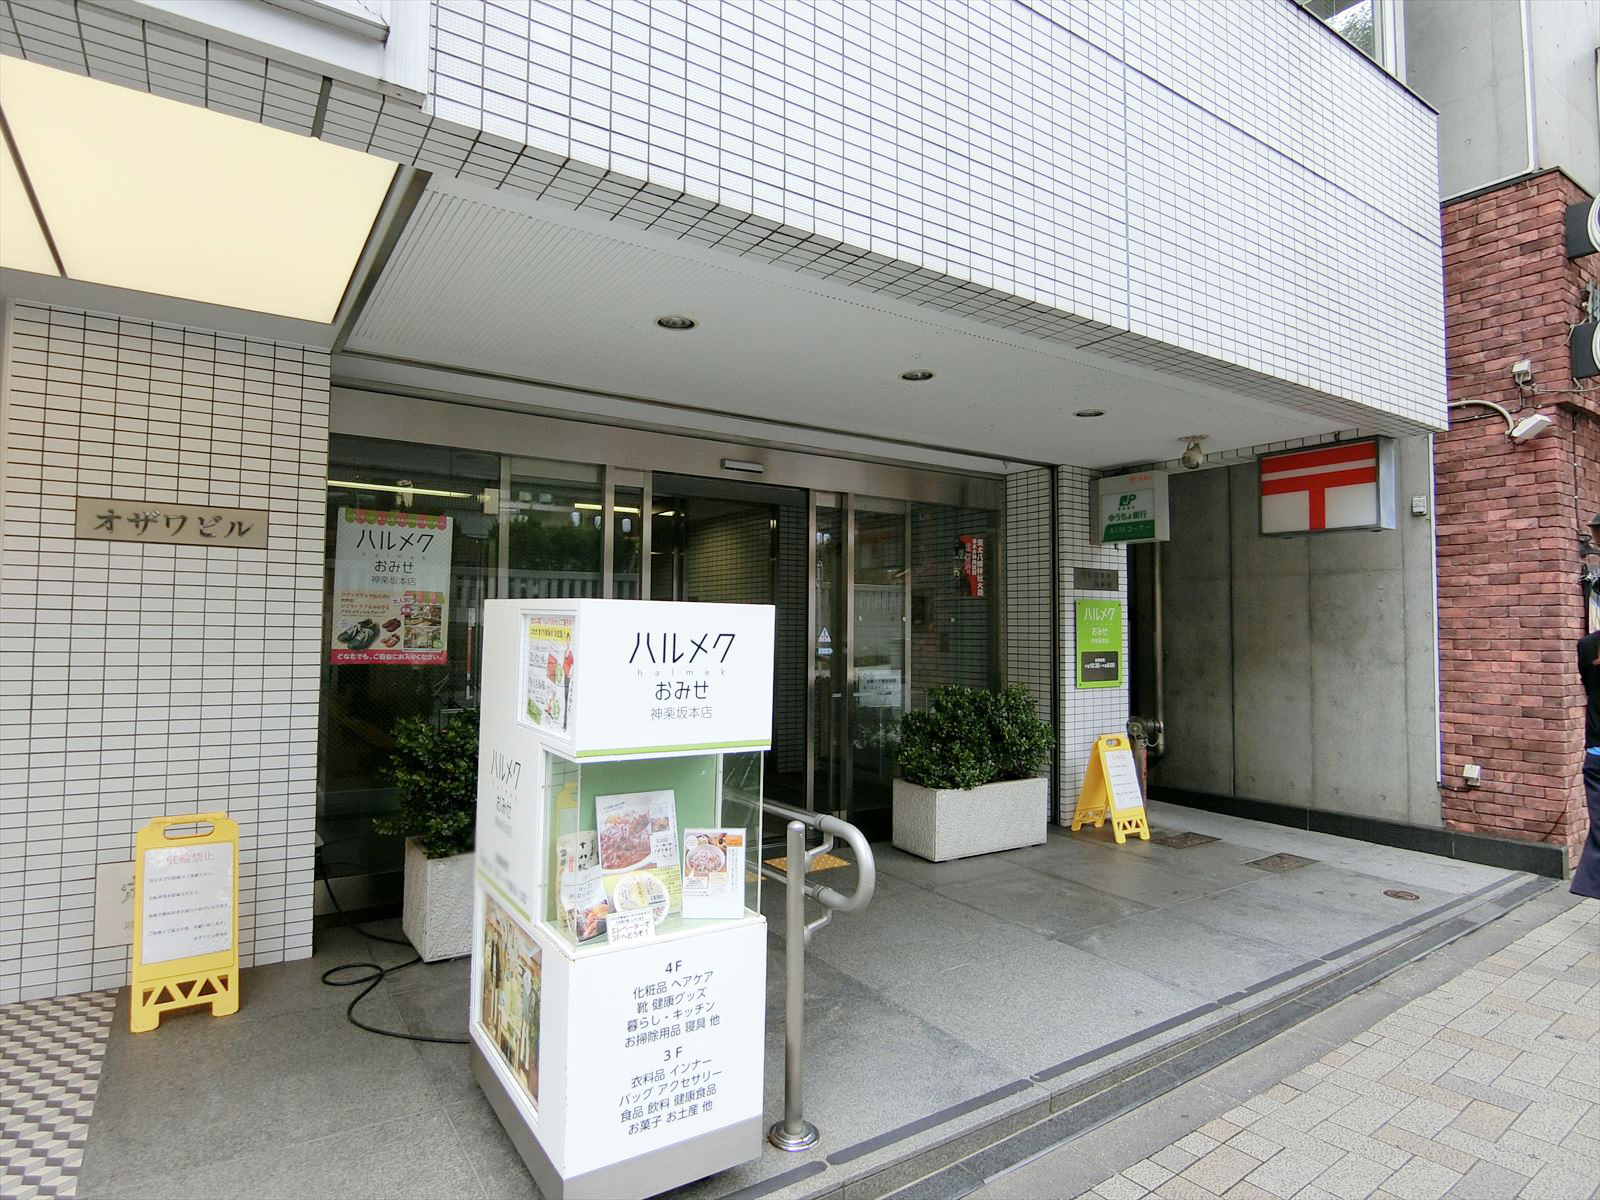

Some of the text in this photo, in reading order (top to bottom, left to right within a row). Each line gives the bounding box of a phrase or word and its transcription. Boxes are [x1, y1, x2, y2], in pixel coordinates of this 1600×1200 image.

[94, 508, 257, 540] オザワビル
[1108, 511, 1147, 521] ゆうちょ銀行
[356, 529, 434, 552] ハルメク
[374, 560, 414, 574] おみせ
[371, 575, 416, 586] 神楽坂本店
[1084, 607, 1116, 621] ハルメク
[1092, 627, 1109, 636] おみせ
[629, 632, 736, 664] ハルメク
[637, 668, 726, 677] halmek
[655, 681, 709, 701] おみせ
[650, 705, 712, 721] 神楽坂本店
[491, 750, 521, 790] ハルメク
[496, 796, 512, 819] おみせ
[611, 920, 651, 934] エレベーターで
[665, 960, 684, 974] 4F
[633, 970, 714, 1000] 化粧品 ヘアケア
[637, 987, 708, 1014] 靴 健康グッズ
[627, 1001, 715, 1032] 暮らし・キッチン
[624, 1014, 721, 1049] お掃除用品 寝具 他
[630, 1059, 712, 1089] 衣料品 インナー
[619, 1071, 722, 1107] バッグ アクセサリー
[620, 1083, 717, 1123] 食品 飲料 健康食品
[628, 1099, 713, 1136] お菓子 お土産 他
